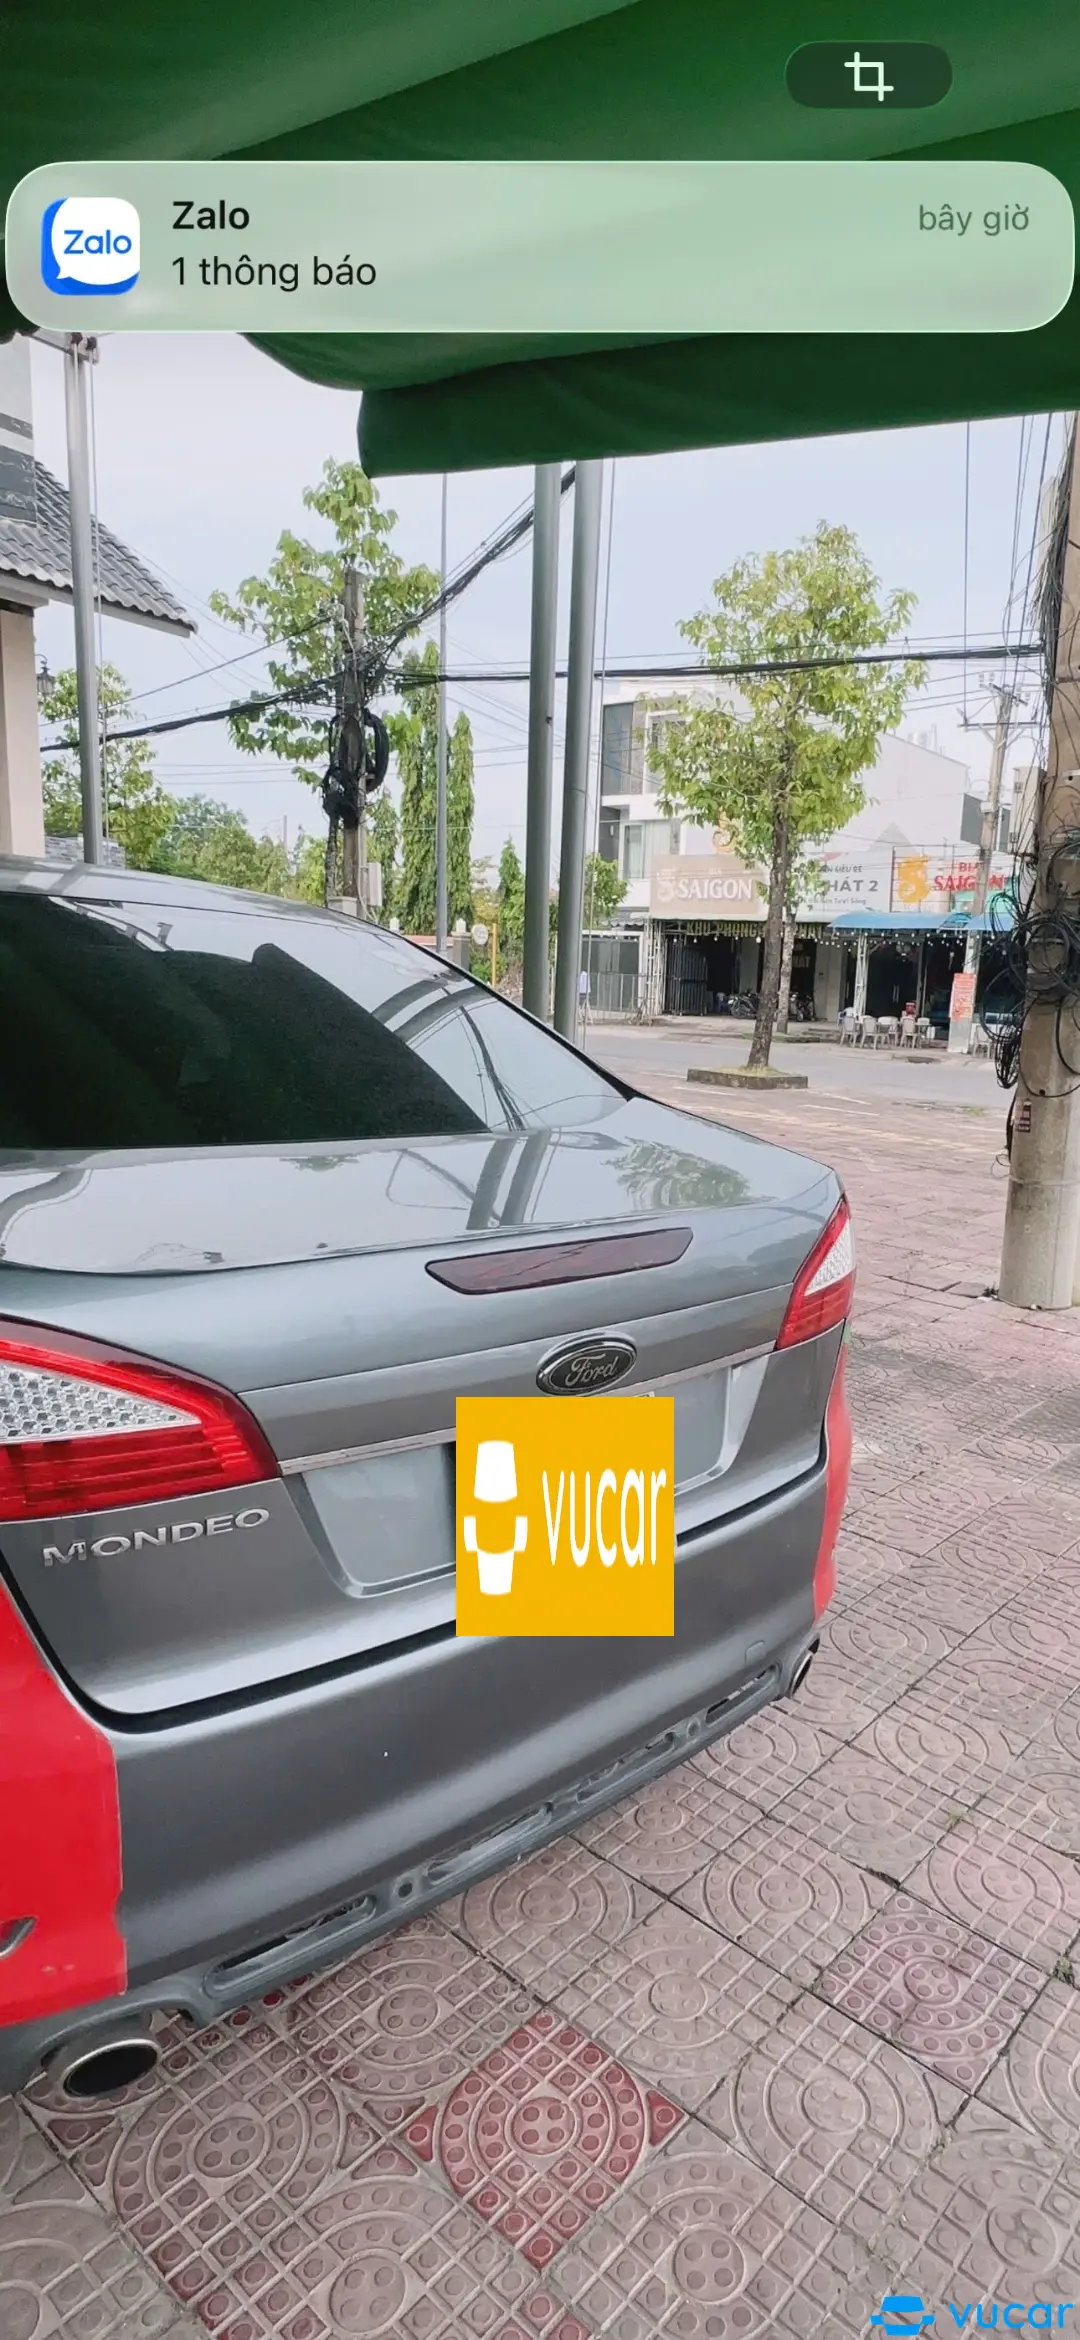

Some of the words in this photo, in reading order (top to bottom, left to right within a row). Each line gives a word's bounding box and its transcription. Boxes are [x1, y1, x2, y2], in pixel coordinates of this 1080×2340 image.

[677, 878, 753, 900] SAIGON
[868, 880, 878, 892] 2
[934, 875, 1004, 891] SAIGN
[565, 1353, 618, 1387] Ford
[43, 1508, 270, 1566] MONDEO
